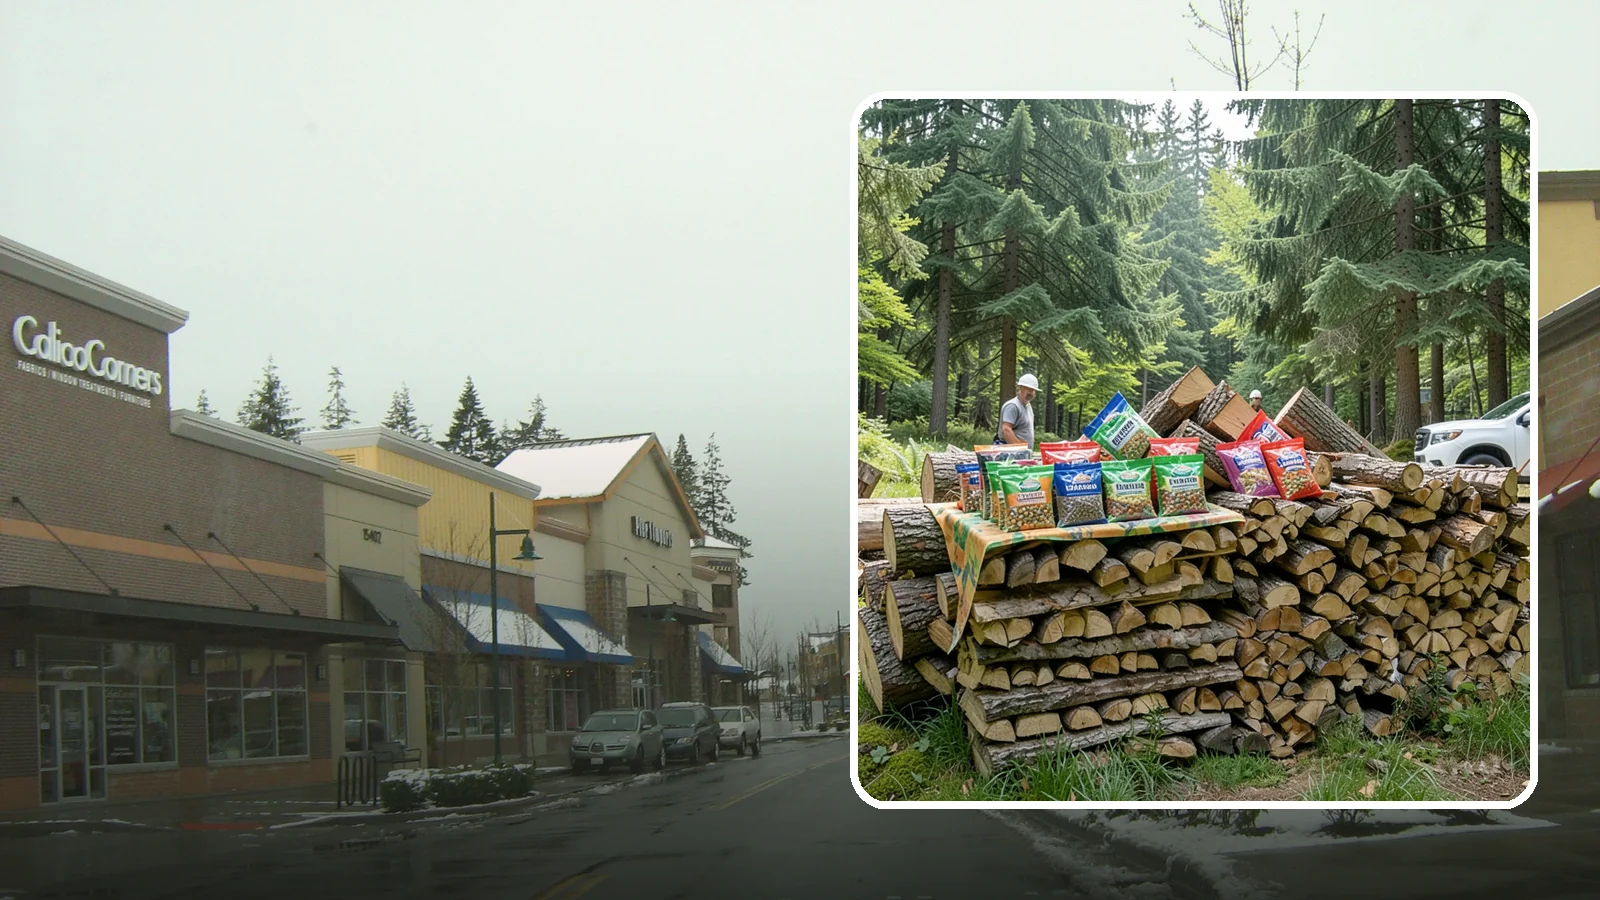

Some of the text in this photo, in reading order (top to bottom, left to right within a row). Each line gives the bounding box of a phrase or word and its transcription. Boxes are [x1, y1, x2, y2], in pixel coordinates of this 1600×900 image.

[18, 360, 151, 408] FABRICS WINDOW TREATMENTS FURNITURE
